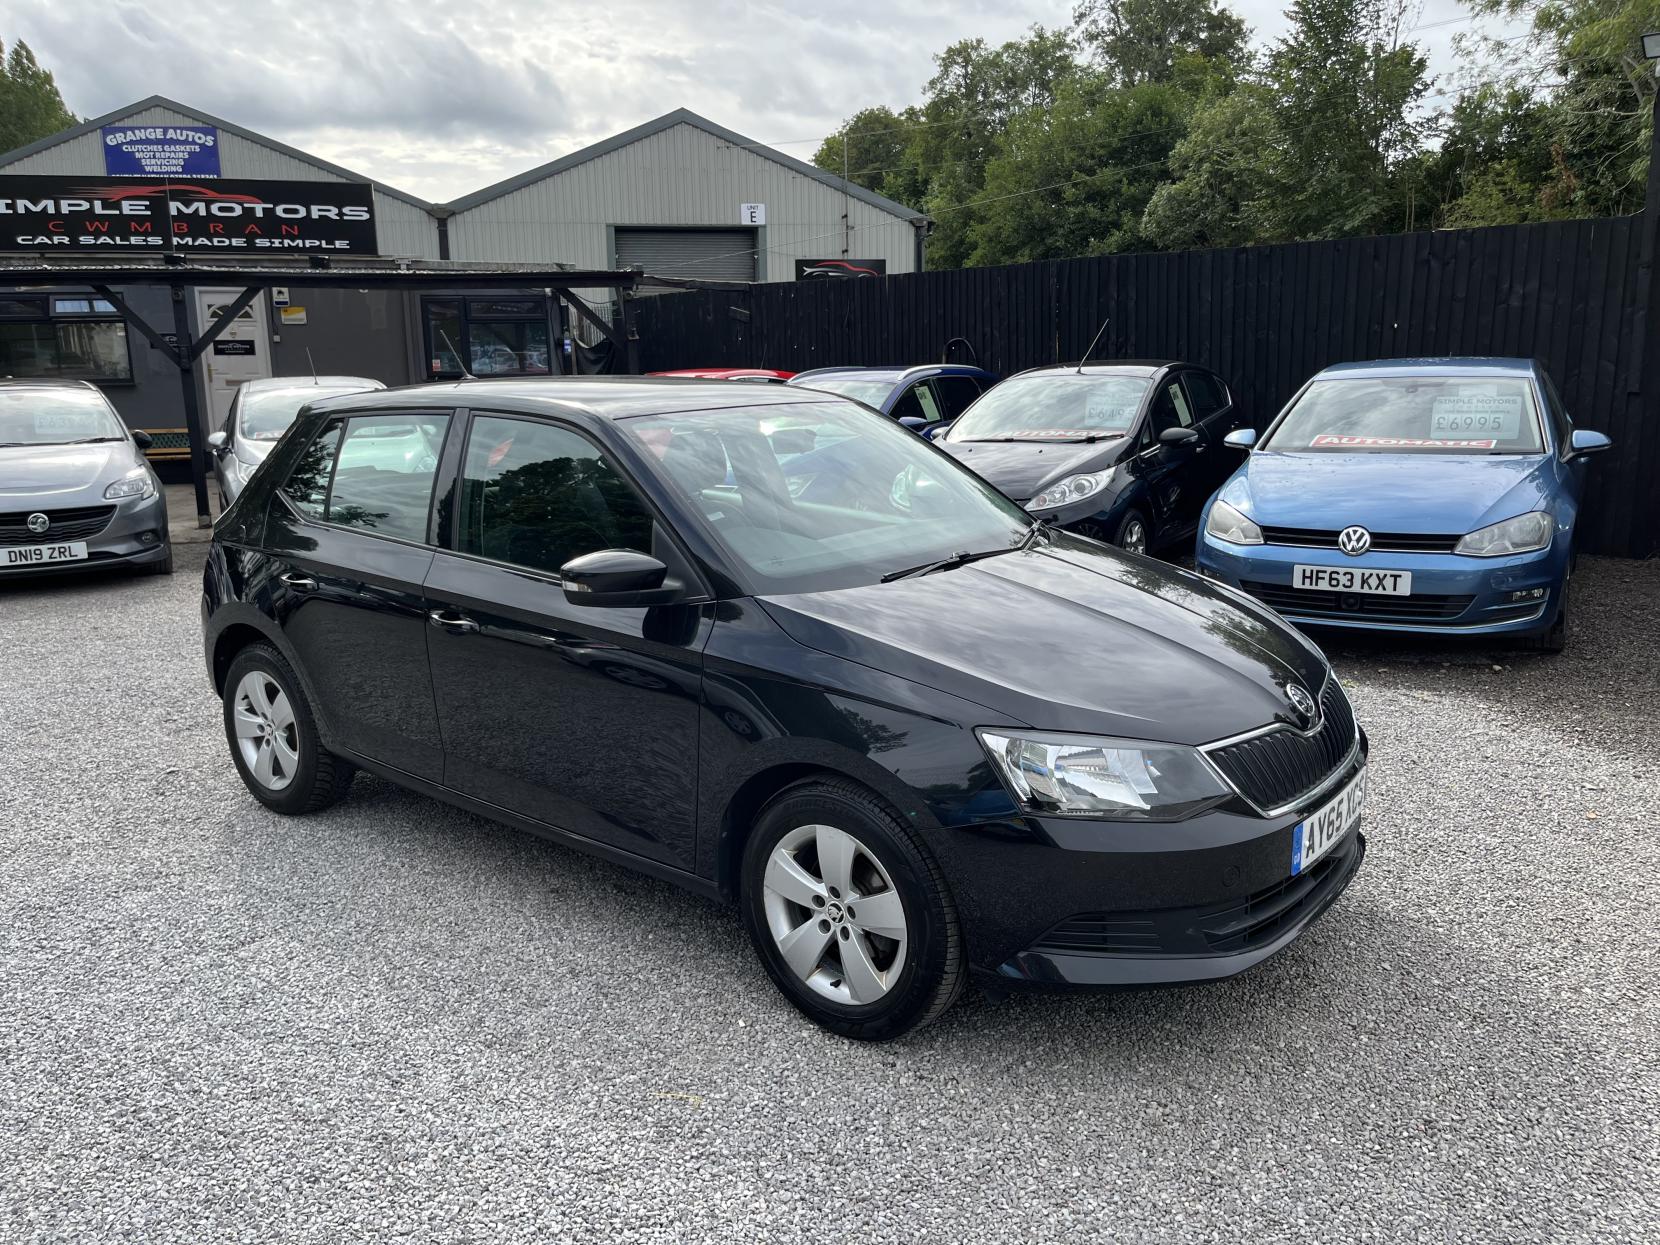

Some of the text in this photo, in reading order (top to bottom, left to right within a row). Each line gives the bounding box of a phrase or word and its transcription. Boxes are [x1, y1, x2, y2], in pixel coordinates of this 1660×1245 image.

[106, 128, 214, 146] GRANGE AUTOS
[0, 199, 371, 221] IMPLE MOTORS
[750, 211, 756, 223] E
[17, 236, 350, 249] CAR SALES MADE SIMPLE
[1436, 416, 1501, 430] £6995
[1319, 437, 1486, 447] AUTOMATIC
[8, 545, 79, 563] DN19 ZRL
[1301, 568, 1402, 592] HF63 KXT
[1305, 797, 1344, 859] AY65
